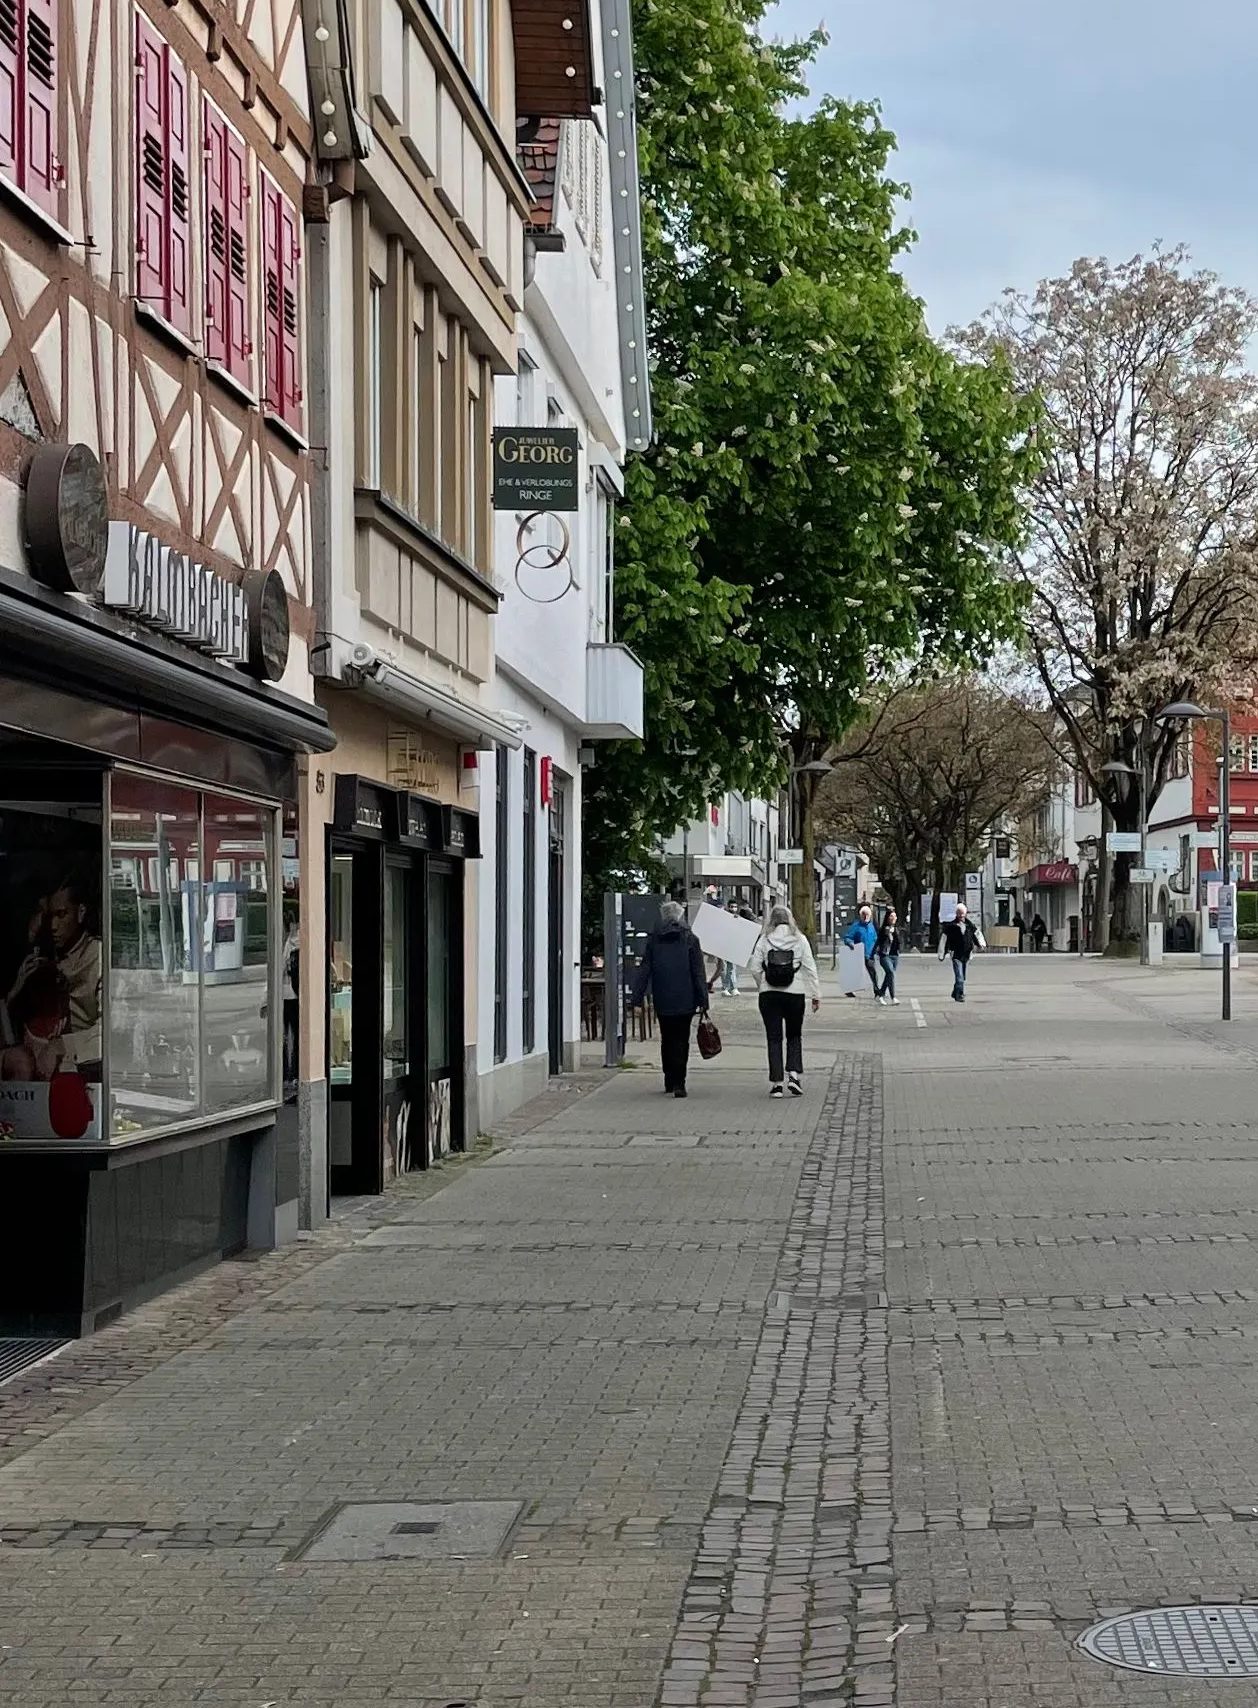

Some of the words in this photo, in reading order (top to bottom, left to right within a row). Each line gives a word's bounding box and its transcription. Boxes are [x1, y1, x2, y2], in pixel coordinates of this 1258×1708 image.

[498, 436, 573, 464] GEORG
[498, 477, 513, 486] EHE
[514, 477, 521, 486] &
[522, 478, 573, 487] VERLOBUNGS
[519, 490, 552, 501] RINGE
